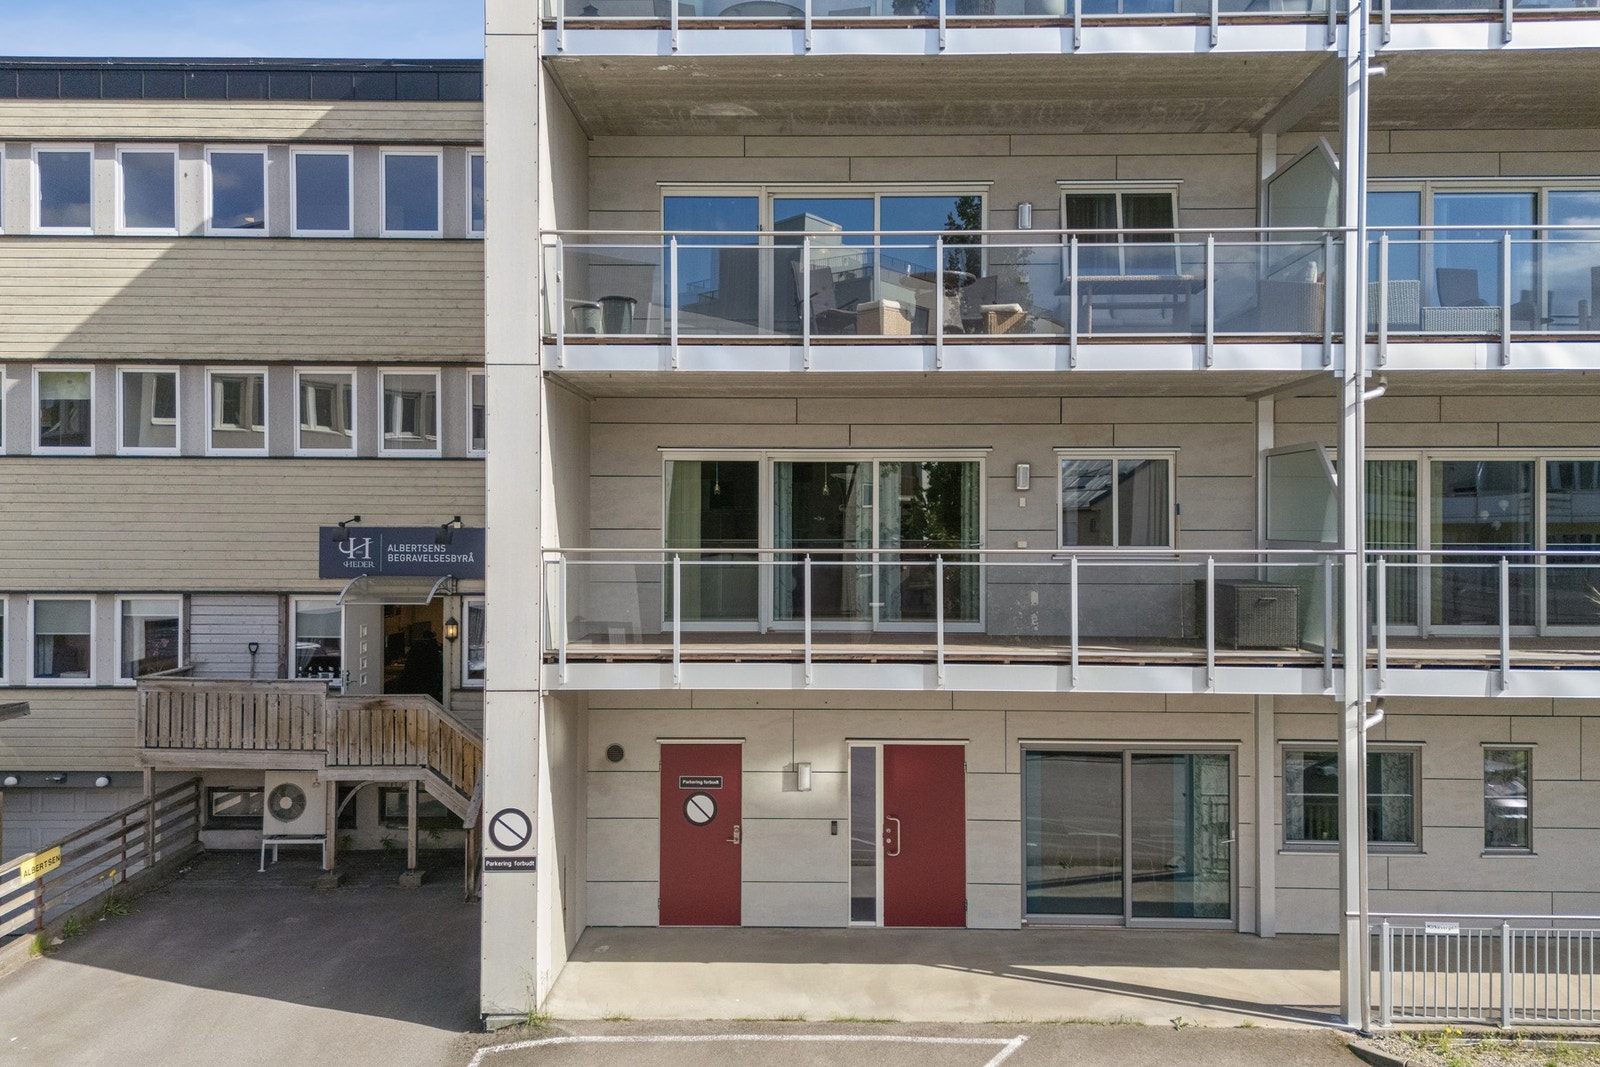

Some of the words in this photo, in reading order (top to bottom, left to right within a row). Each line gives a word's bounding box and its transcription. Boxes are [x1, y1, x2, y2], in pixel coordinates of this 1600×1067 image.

[387, 543, 446, 553] ALBERTSENS
[387, 552, 475, 563] BEGRAVELSESBYRÅ
[343, 560, 375, 568] HEDER
[23, 855, 61, 877] ALBERTSEN
[485, 860, 512, 868] Parkering
